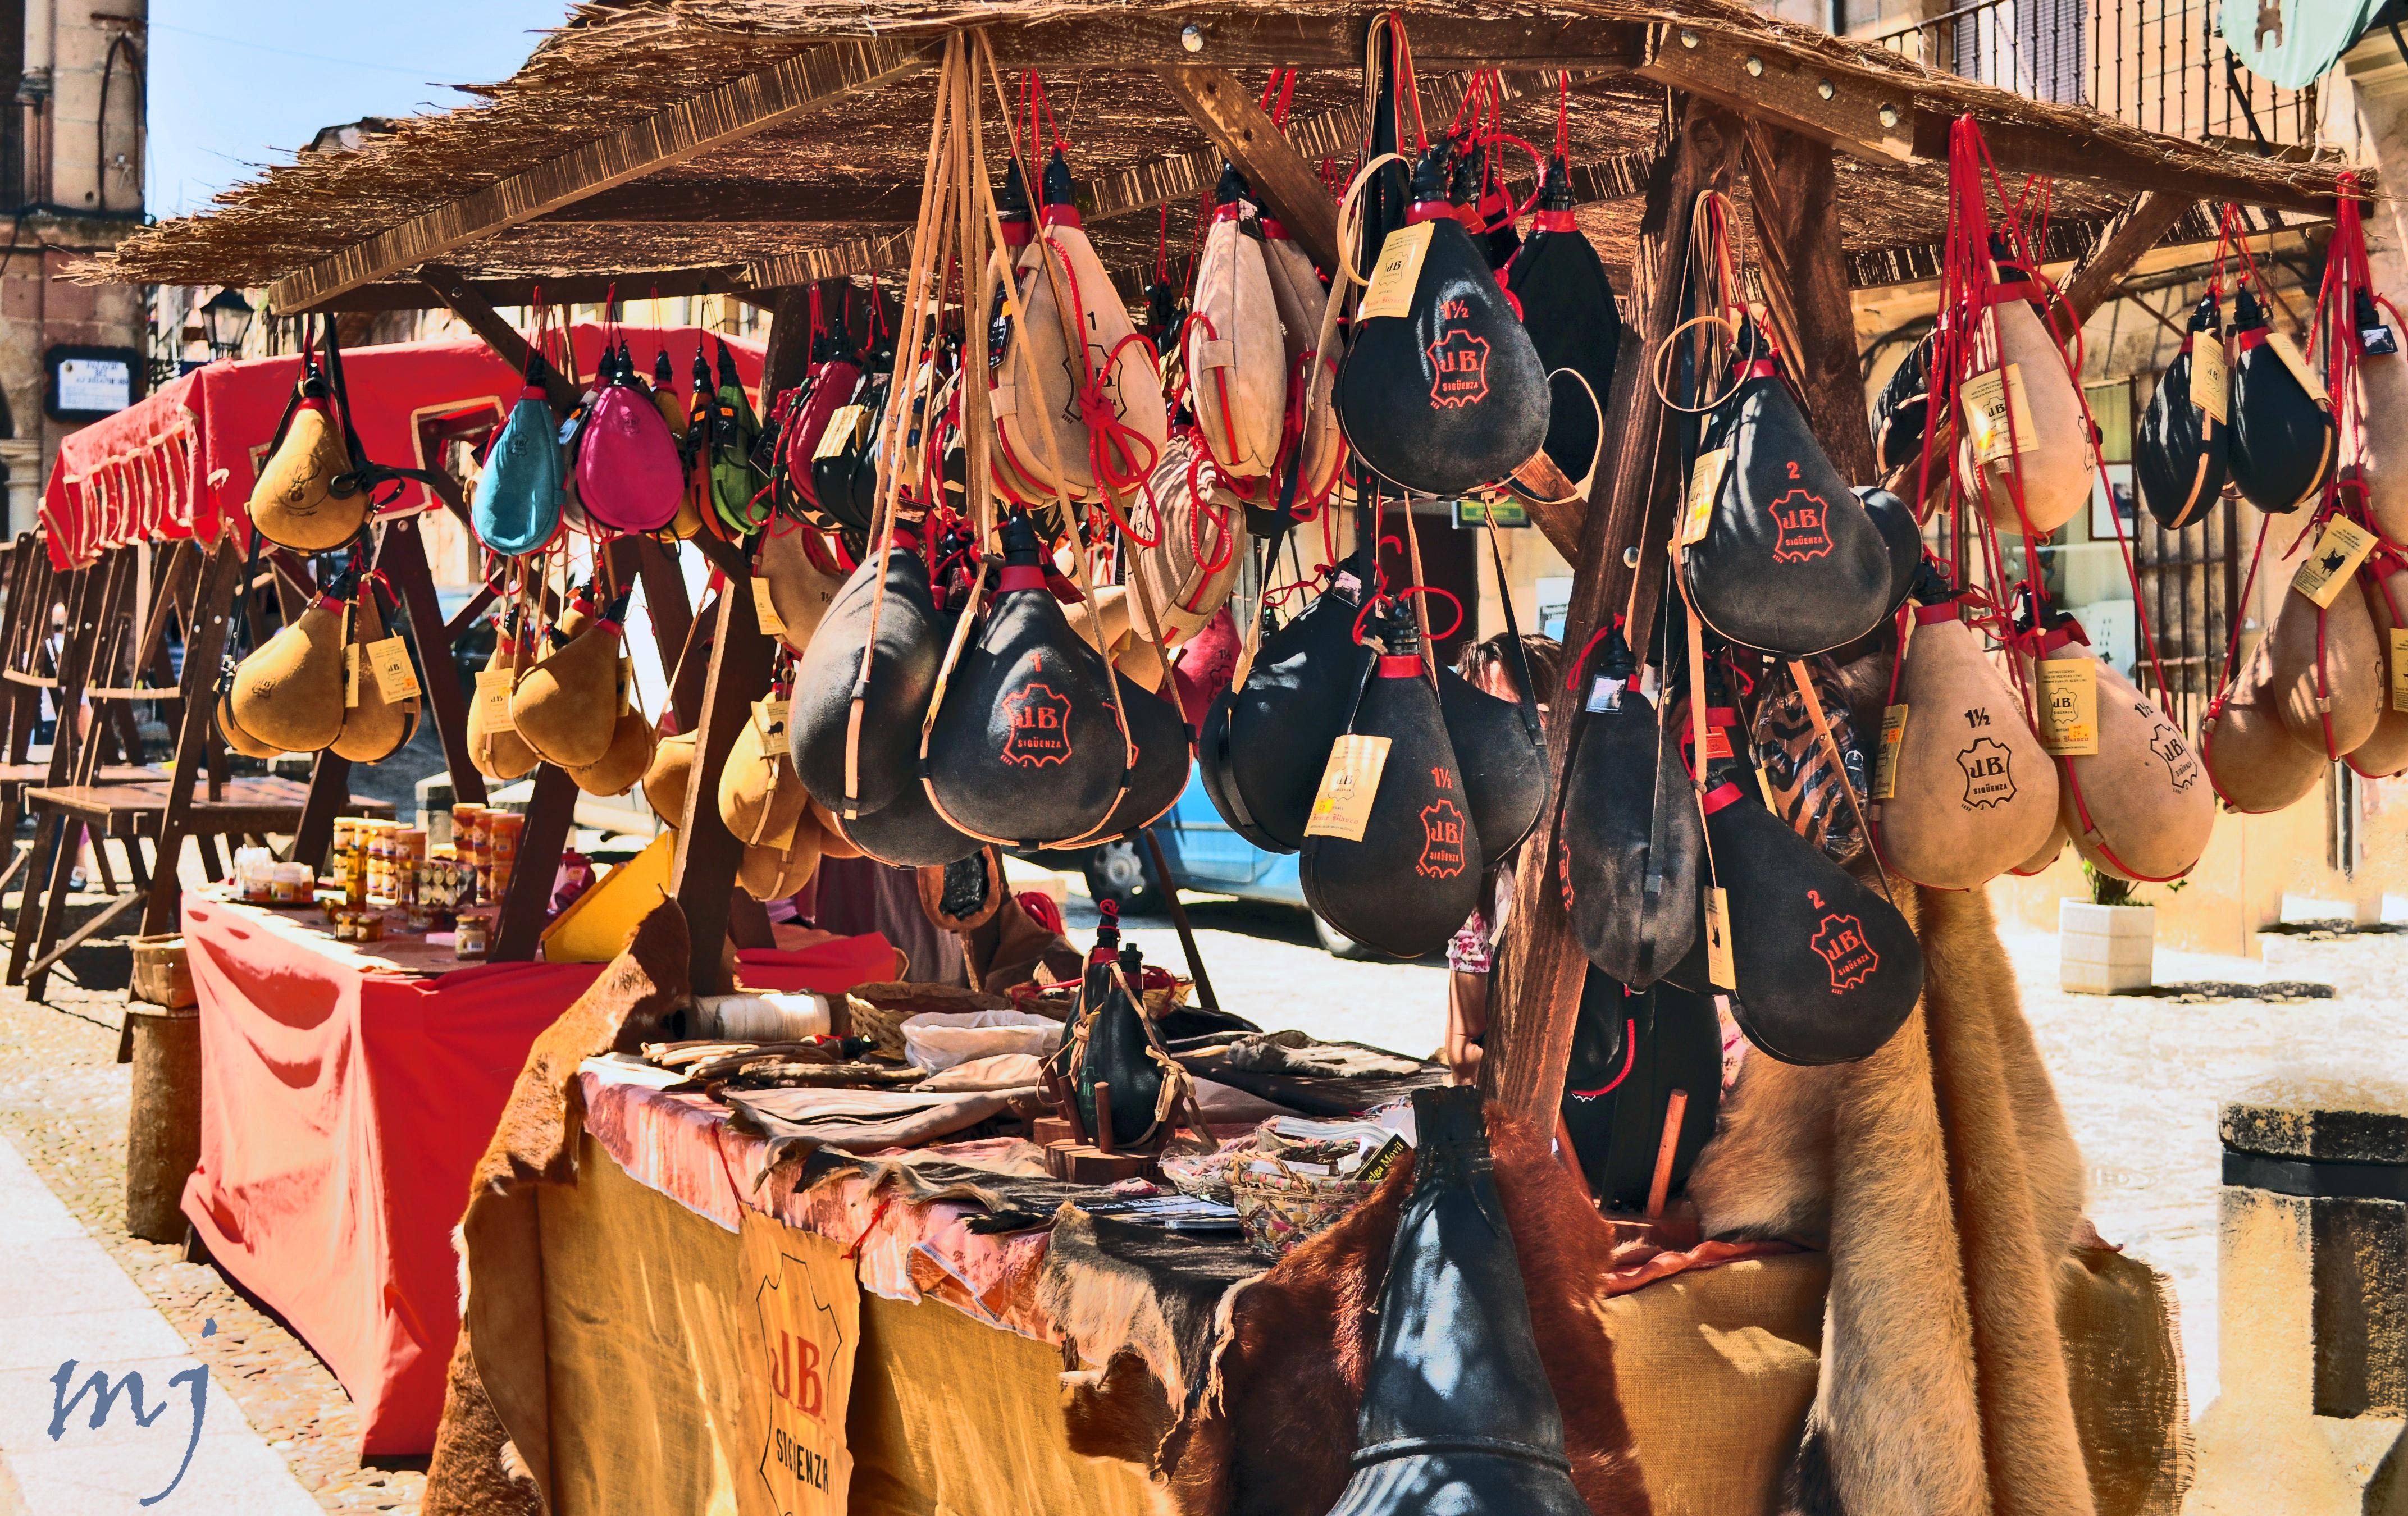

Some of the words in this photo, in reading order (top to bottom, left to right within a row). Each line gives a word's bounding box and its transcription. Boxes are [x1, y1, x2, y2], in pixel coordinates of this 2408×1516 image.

[1087, 311, 1097, 331] 1
[1442, 380, 1479, 392] SIGÜENZA
[1786, 461, 1801, 479] 2
[1785, 535, 1823, 546] SIGÜENZA
[1029, 652, 1042, 672] 1
[1018, 736, 1061, 748] SIGÜENZA
[1973, 783, 2008, 795] SIGÜENZA
[1807, 890, 1825, 909] 2
[1837, 953, 1869, 976] SIGÜENZA
[1380, 1141, 1404, 1167] Móvil
